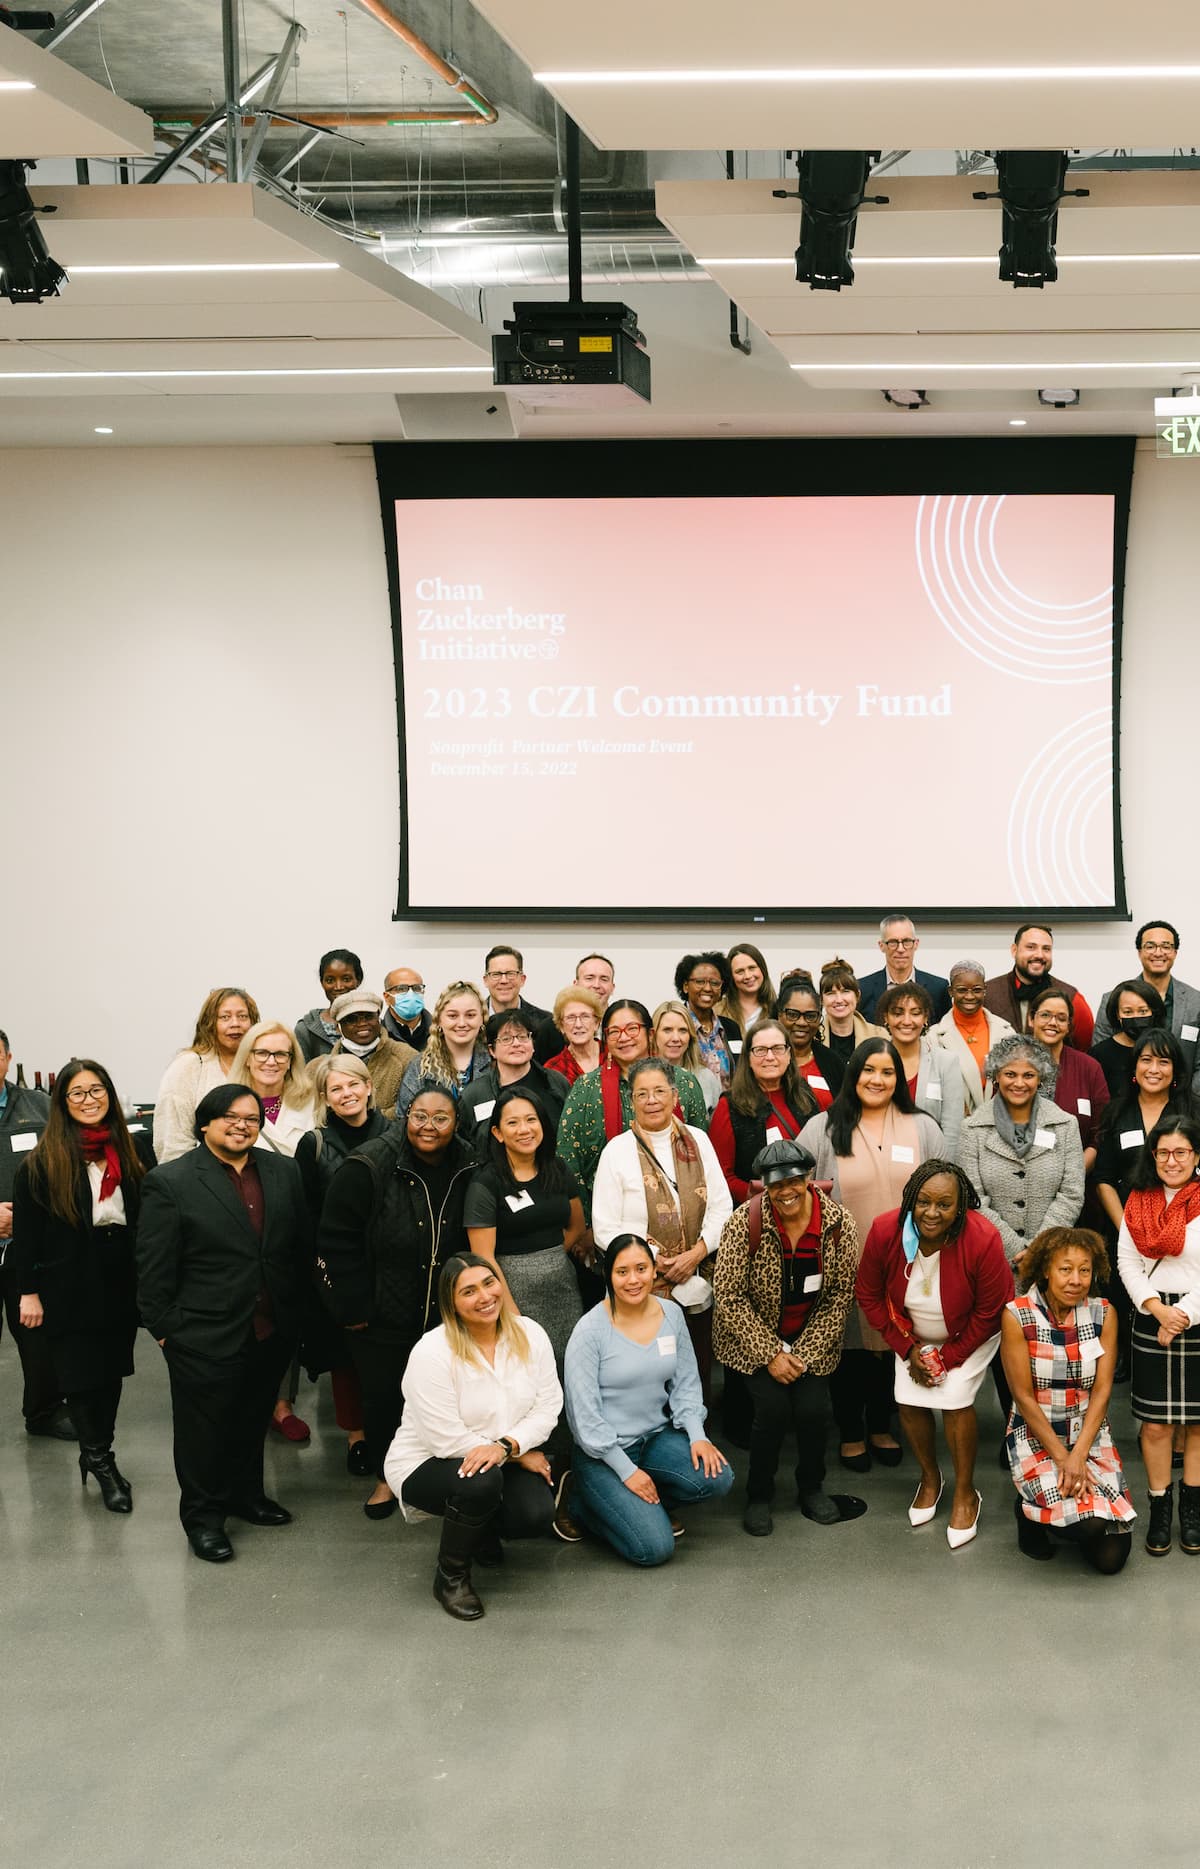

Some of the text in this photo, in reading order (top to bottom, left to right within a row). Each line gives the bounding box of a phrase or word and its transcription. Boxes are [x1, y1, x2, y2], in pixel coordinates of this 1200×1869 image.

[415, 576, 485, 601] Chan
[416, 605, 567, 636] Zuckerberg
[417, 635, 537, 660] Initiative
[423, 683, 952, 726] 2023 CZI Community Fund
[429, 737, 694, 759] Nonprofit Partner Welcome Event
[430, 760, 505, 776] December
[538, 760, 577, 775] 2022
